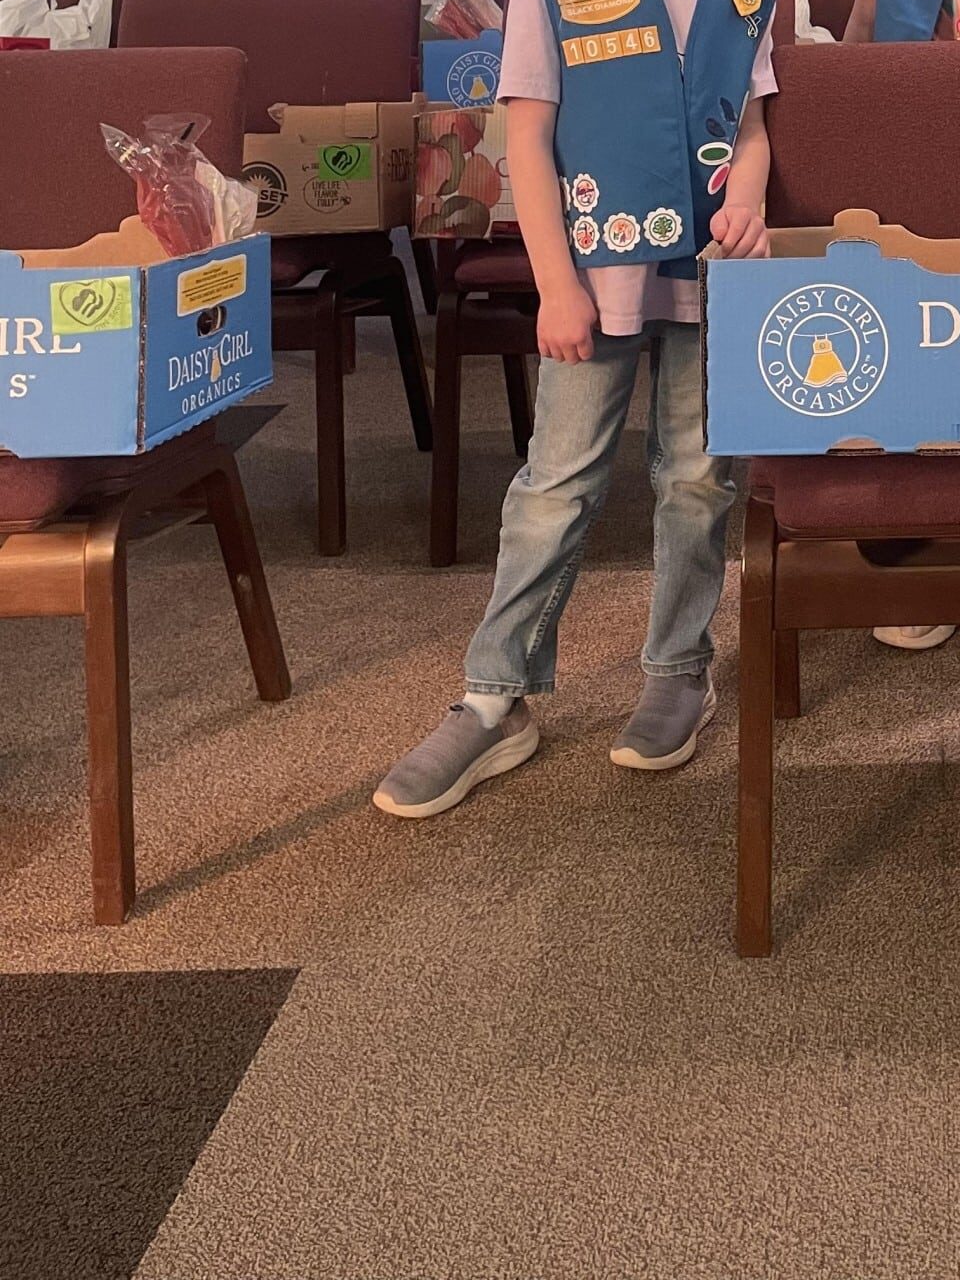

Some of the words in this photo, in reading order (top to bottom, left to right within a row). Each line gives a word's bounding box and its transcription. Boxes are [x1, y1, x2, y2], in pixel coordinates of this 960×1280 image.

[567, 1, 593, 17] BLACK
[569, 31, 656, 61] 10546
[450, 54, 480, 81] DAISY
[483, 55, 501, 78] GIR
[260, 189, 289, 204] SET
[0, 317, 81, 356] IRL
[765, 290, 826, 347] DAISY
[834, 294, 880, 344] GIRL
[168, 346, 211, 392] DAISY
[219, 330, 253, 367] GIRL
[181, 372, 242, 415] ORGANICS
[768, 361, 879, 410] ORGANICS
